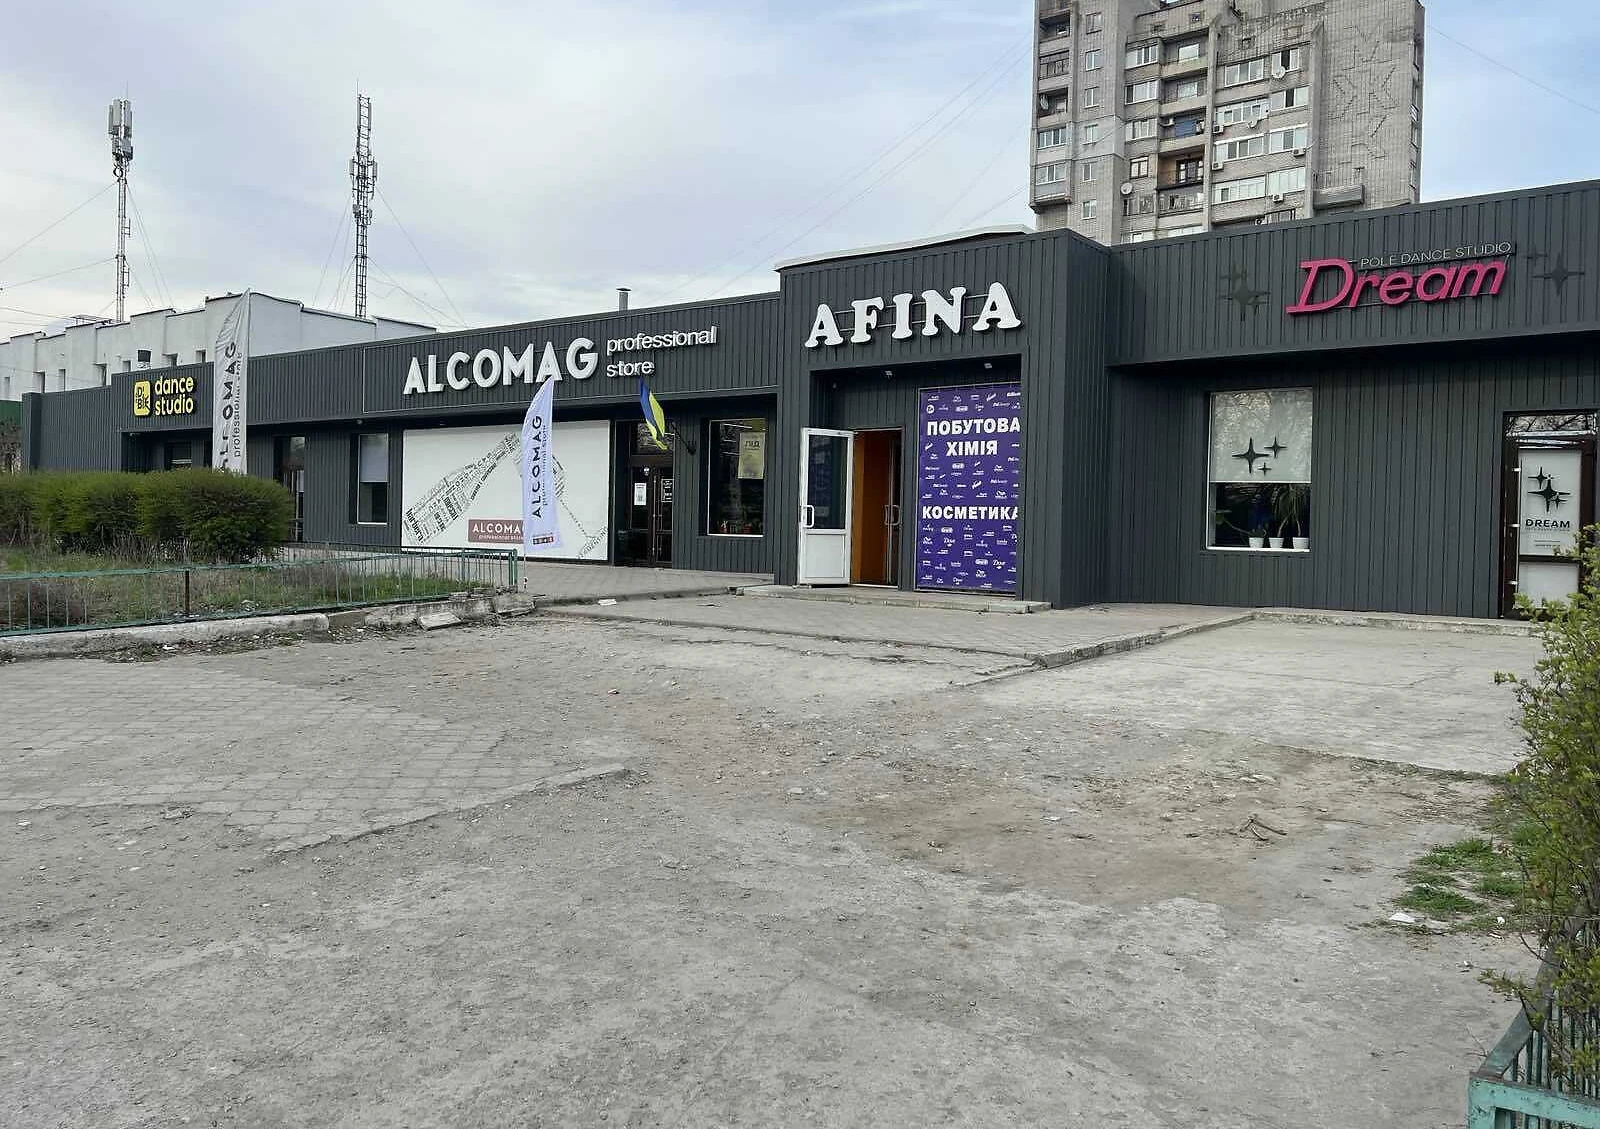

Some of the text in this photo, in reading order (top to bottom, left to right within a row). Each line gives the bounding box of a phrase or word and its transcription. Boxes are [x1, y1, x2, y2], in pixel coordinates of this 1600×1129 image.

[1360, 241, 1512, 269] POLE DANCE STUDIO
[1284, 257, 1509, 314] Dream
[804, 282, 1022, 349] AFINA
[403, 326, 718, 395] ALCOMAG professional
[606, 358, 655, 378] store
[154, 376, 194, 395] dance
[155, 394, 194, 416] studio
[927, 416, 1020, 436] ПОБУТОВА
[946, 440, 998, 457] ХІМІЯ
[532, 415, 543, 519] ALCOMAG
[472, 522, 525, 534] ALCOMA
[1525, 518, 1570, 528] DREAM
